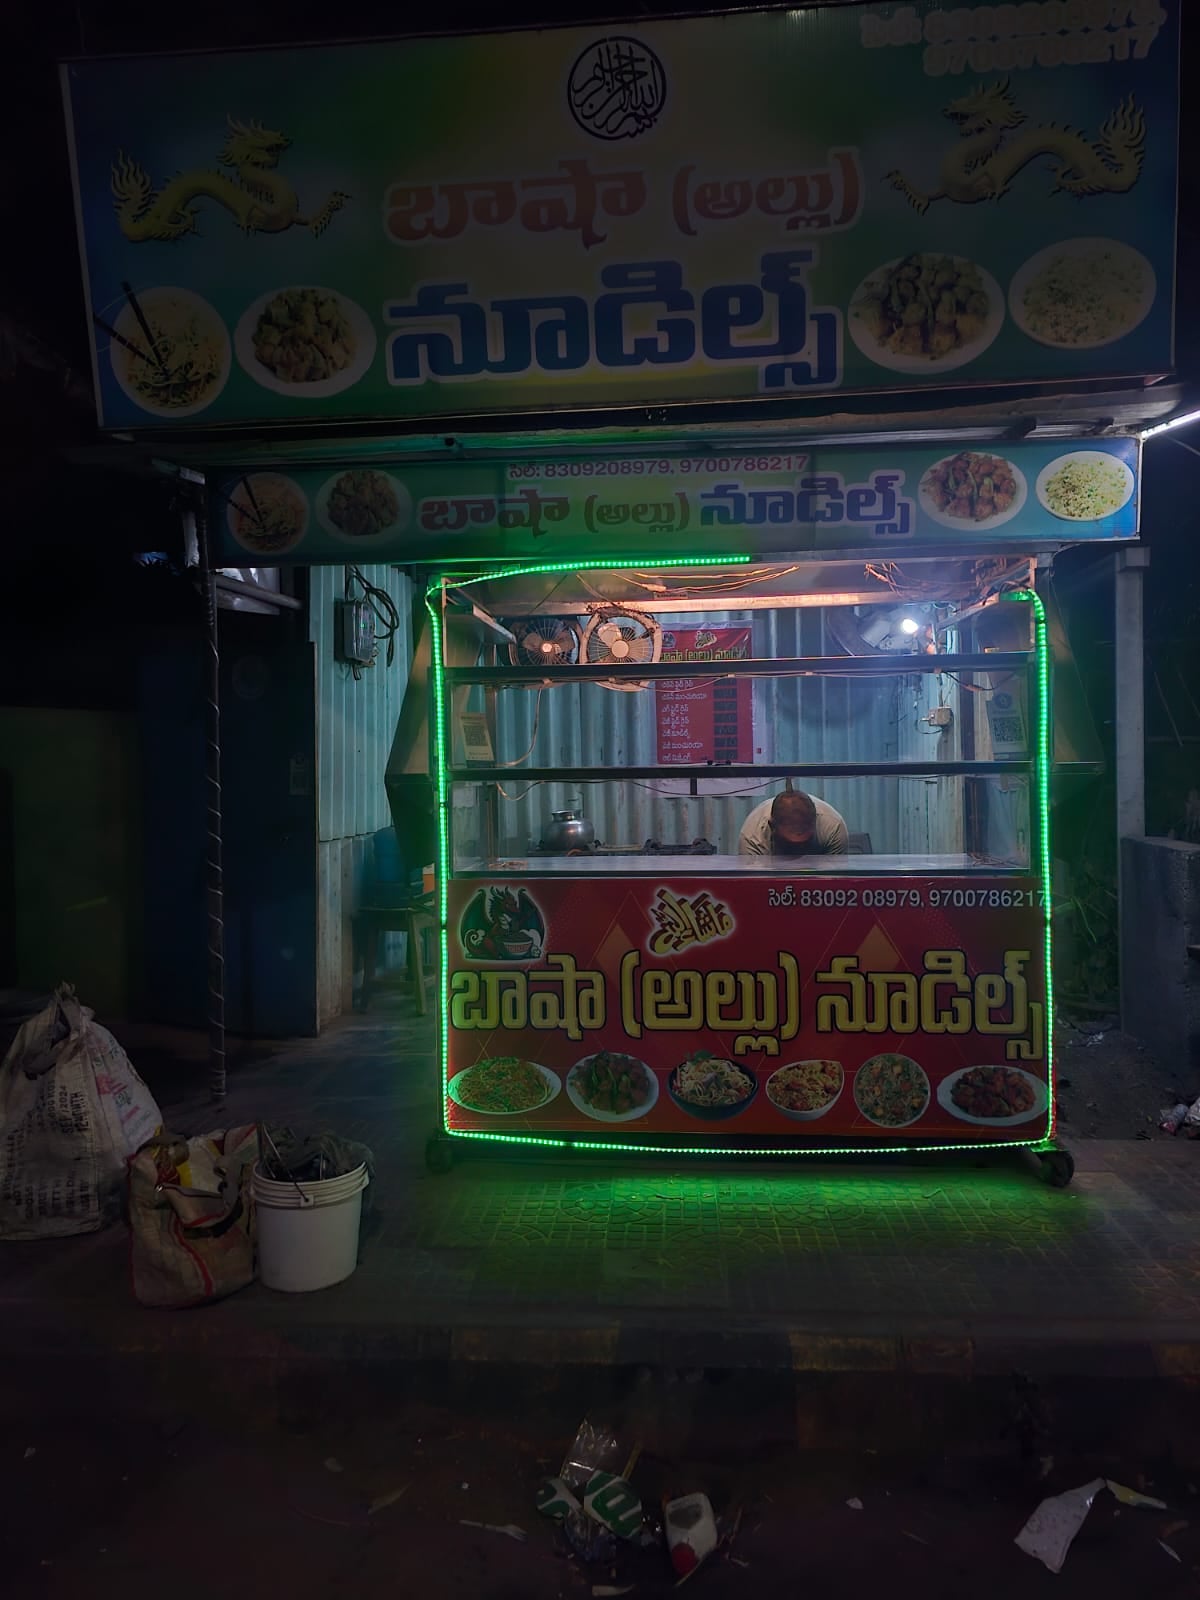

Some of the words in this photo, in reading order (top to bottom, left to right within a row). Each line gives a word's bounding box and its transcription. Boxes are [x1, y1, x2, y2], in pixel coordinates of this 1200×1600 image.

[387, 158, 647, 251] బాషా
[672, 151, 860, 237] (అల్లు)
[388, 249, 838, 388] నూడిల్స్
[420, 488, 570, 539] బాషా
[583, 491, 690, 533] (అల్లు)
[700, 474, 910, 536] నూడిల్స్
[544, 459, 675, 478] 8309208979,
[679, 455, 809, 473] 9700786217
[767, 885, 797, 907] సెల్:
[800, 889, 858, 907] 83092
[929, 889, 1046, 907] 9700786217
[448, 951, 607, 1041] బాషా
[620, 949, 801, 1057] (అల్లు)
[815, 948, 1045, 1061] నూడిల్స్
